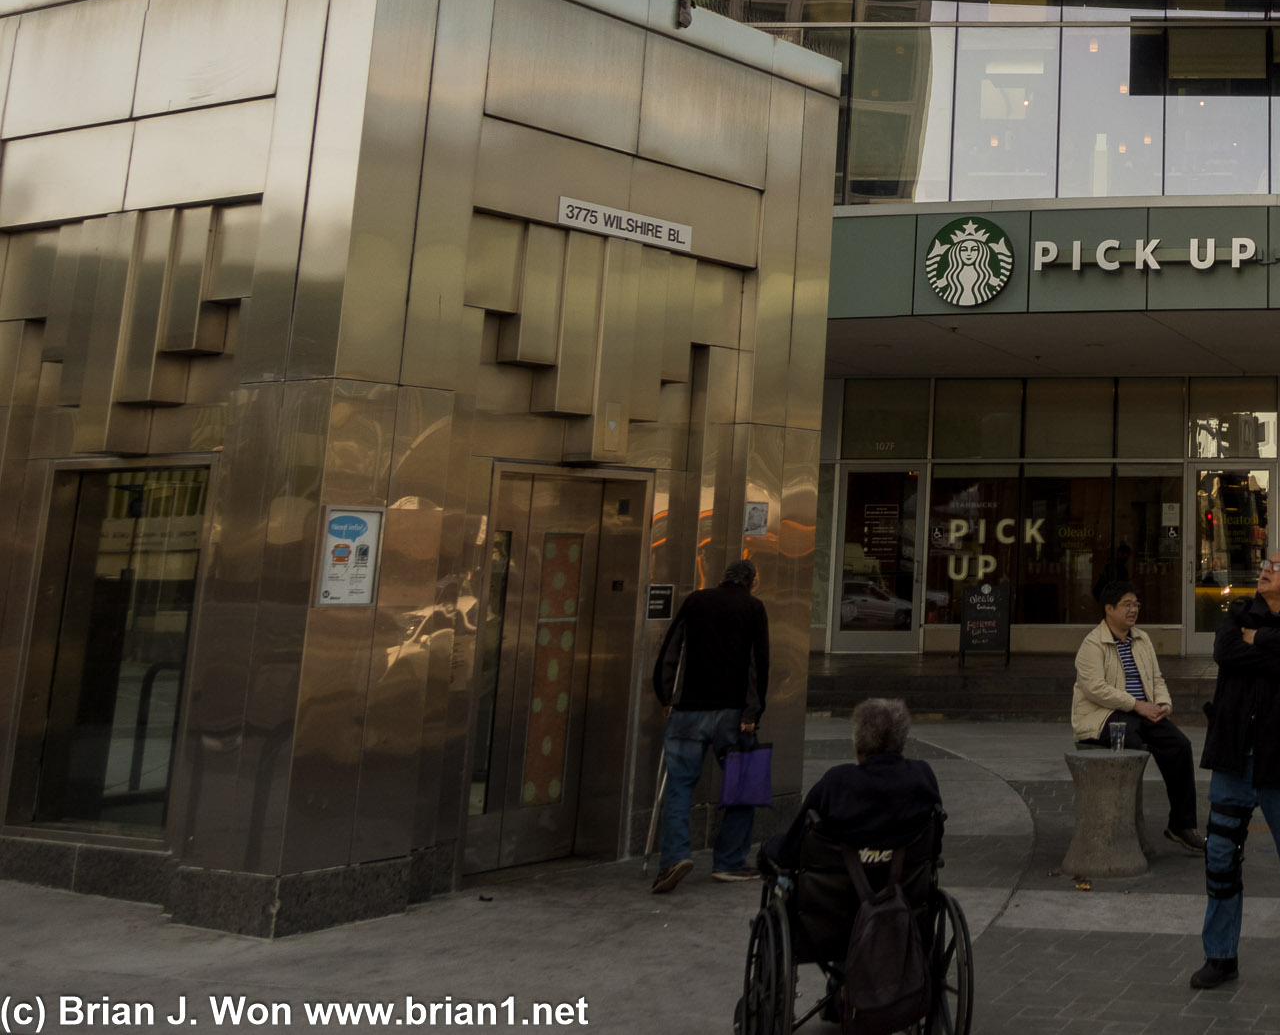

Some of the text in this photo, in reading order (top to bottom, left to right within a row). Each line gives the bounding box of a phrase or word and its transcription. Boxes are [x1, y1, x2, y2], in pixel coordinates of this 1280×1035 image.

[566, 204, 685, 244] 3775 WILSHIRE BL.
[1033, 237, 1256, 271] PICK UP
[949, 518, 1046, 544] PICK
[1058, 525, 1096, 538] Oleato
[948, 554, 998, 581] UP
